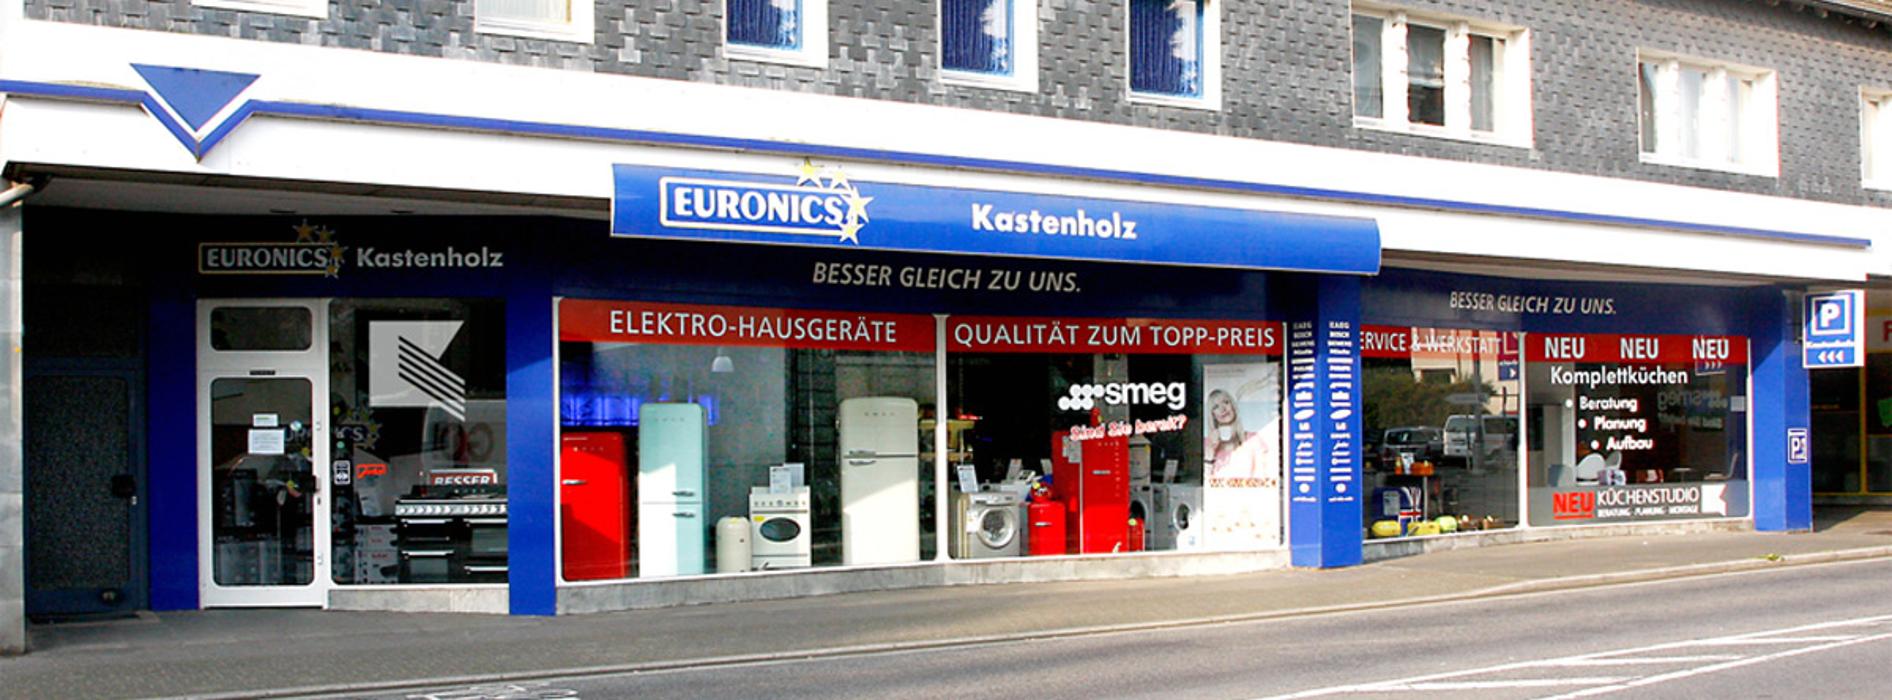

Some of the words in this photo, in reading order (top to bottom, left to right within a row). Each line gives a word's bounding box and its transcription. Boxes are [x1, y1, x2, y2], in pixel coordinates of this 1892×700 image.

[674, 187, 843, 226] EURONICS
[972, 203, 1138, 240] Kastenholz
[207, 248, 327, 267] EURONICS
[357, 246, 504, 268] Kastenholz
[813, 262, 892, 286] BESSER
[900, 266, 981, 290] GLEICH
[988, 270, 1021, 290] ZU
[1028, 271, 1081, 293] UNS.
[1450, 291, 1494, 311] BESSER
[1498, 294, 1549, 314] GLEICH
[1553, 297, 1575, 314] ZU
[1580, 298, 1617, 315] UNS.
[1821, 302, 1840, 327] P
[610, 310, 897, 342] ELEKTRO-HAUSGERÄTE
[954, 321, 1080, 347] QUALITÄT
[1087, 324, 1141, 346] ZUM
[1149, 325, 1276, 347] TOPP-PREIS
[1360, 331, 1407, 352] ERVICE
[1424, 334, 1501, 354] WERKSTATT
[1545, 336, 1585, 359] NEU
[1620, 337, 1659, 359] NEU
[1692, 338, 1730, 360] NEU
[1550, 365, 1688, 388] Komplettküchen
[1105, 382, 1186, 410] smeg
[1579, 396, 1638, 412] Beratung
[1070, 423, 1106, 441] Sind
[1108, 421, 1132, 437] Sie
[1594, 416, 1647, 431] Planung
[1606, 435, 1653, 450] Aufbau
[434, 475, 491, 485] BESSER
[1553, 491, 1595, 514] NEU
[1598, 487, 1699, 506] KÜCHENSTUDIO
